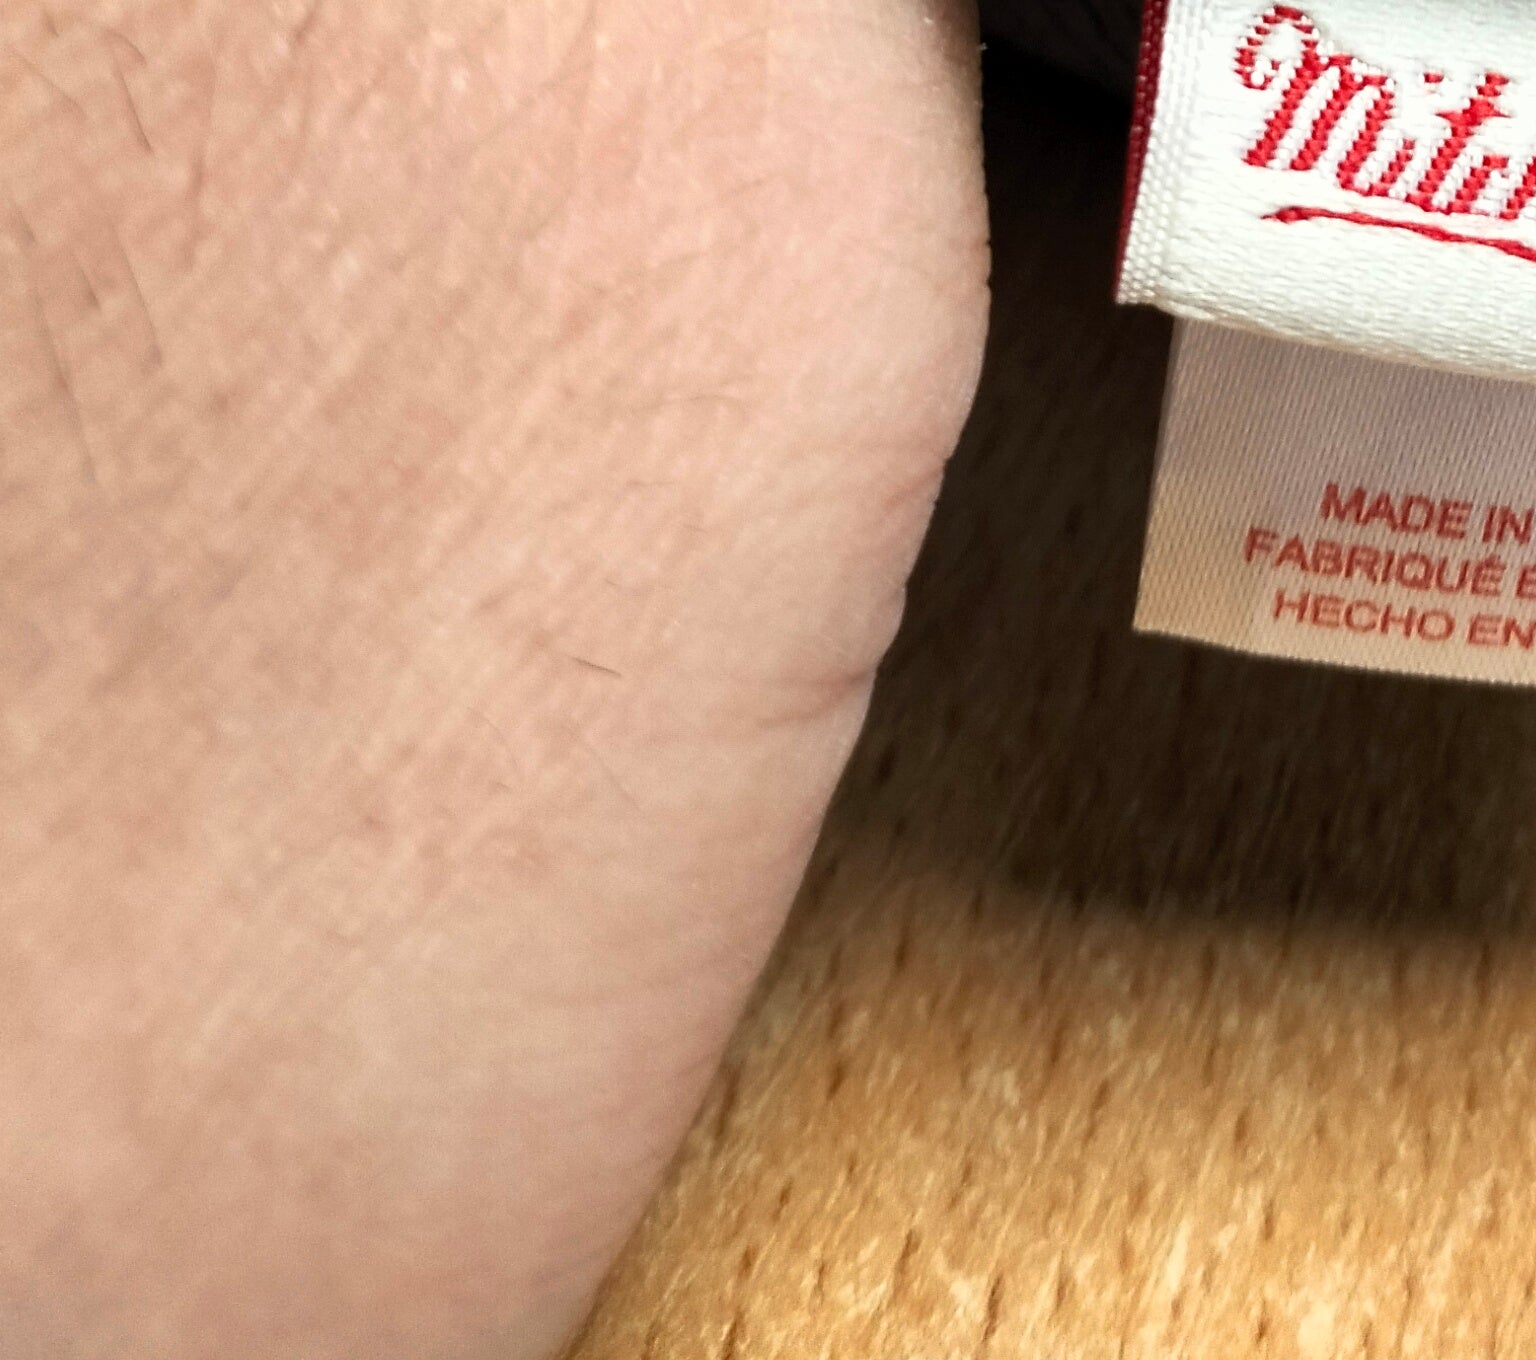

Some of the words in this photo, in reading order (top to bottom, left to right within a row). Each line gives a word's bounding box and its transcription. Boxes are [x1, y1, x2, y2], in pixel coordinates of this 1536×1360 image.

[1319, 483, 1470, 538] MADE
[1483, 503, 1533, 546] IN
[1244, 528, 1507, 597] FABRIQUÉ
[1273, 589, 1455, 642] HECHO
